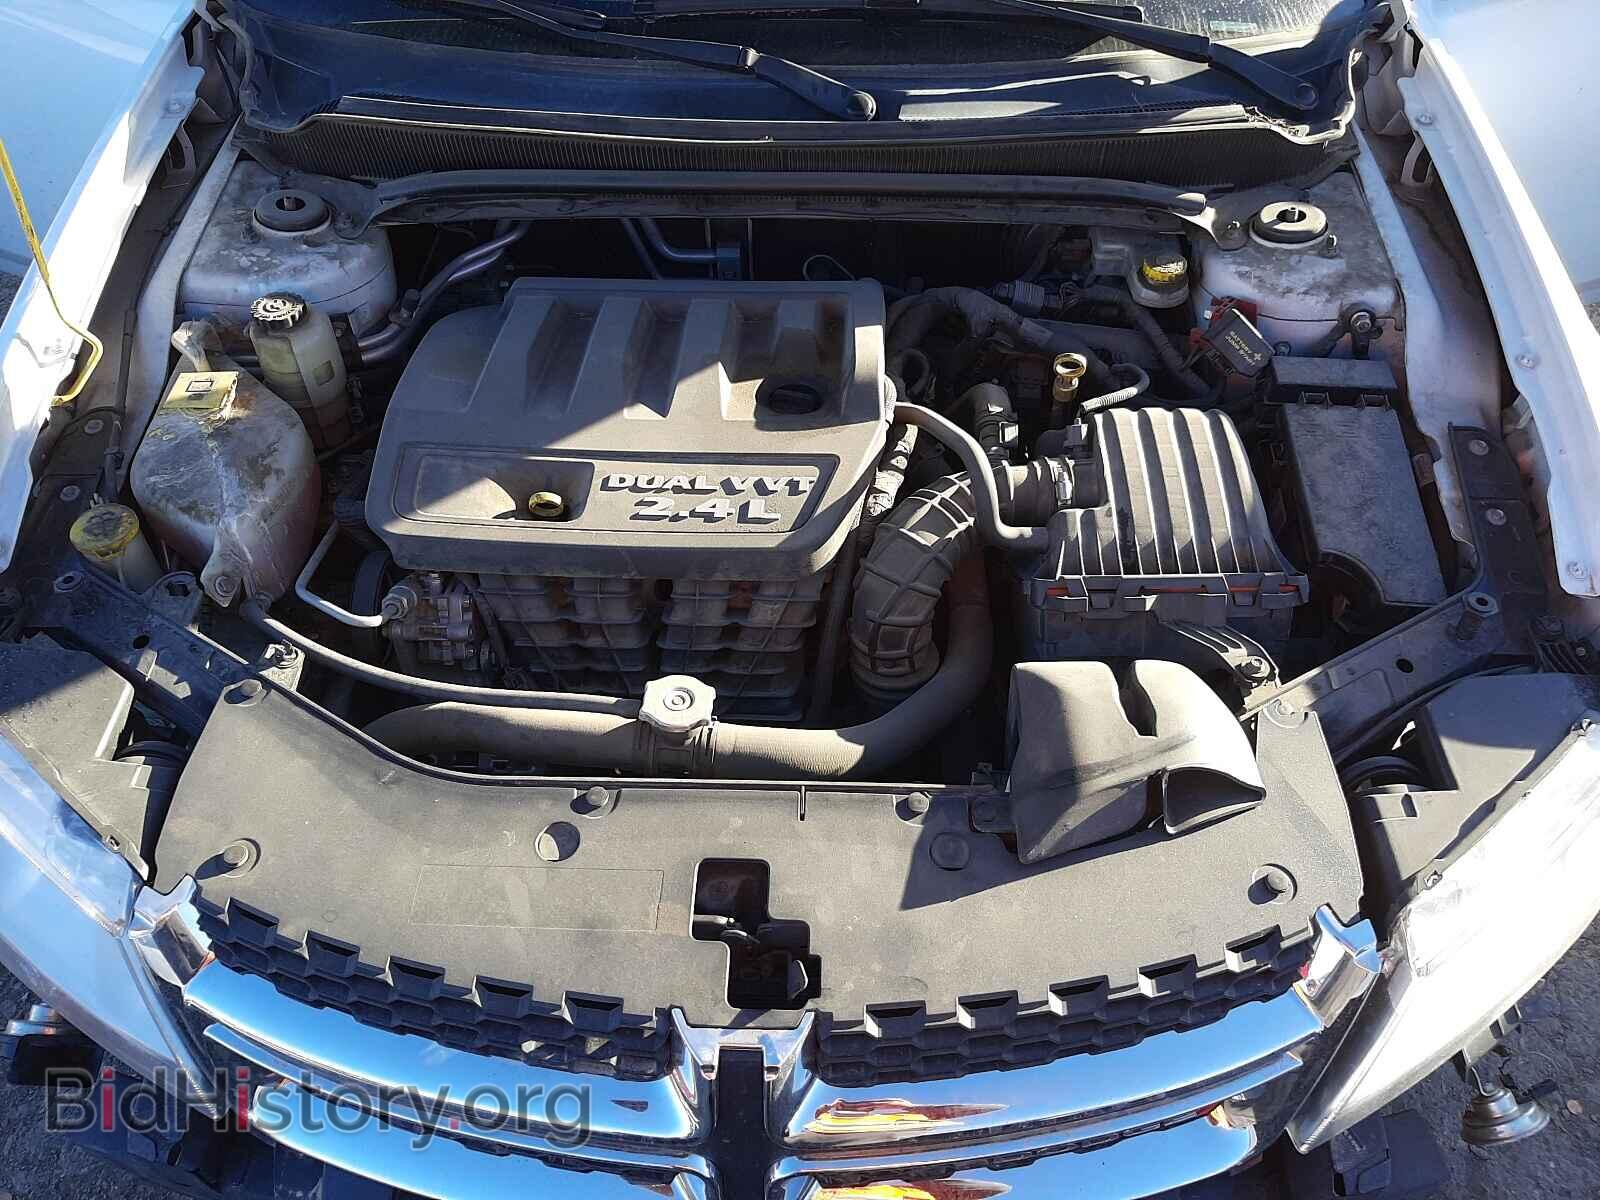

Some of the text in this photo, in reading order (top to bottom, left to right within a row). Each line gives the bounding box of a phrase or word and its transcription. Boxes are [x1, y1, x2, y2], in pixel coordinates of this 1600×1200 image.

[1228, 330, 1252, 354] BATTERY
[600, 473, 815, 496] DUAL VVT
[629, 496, 782, 524] 2.4L
